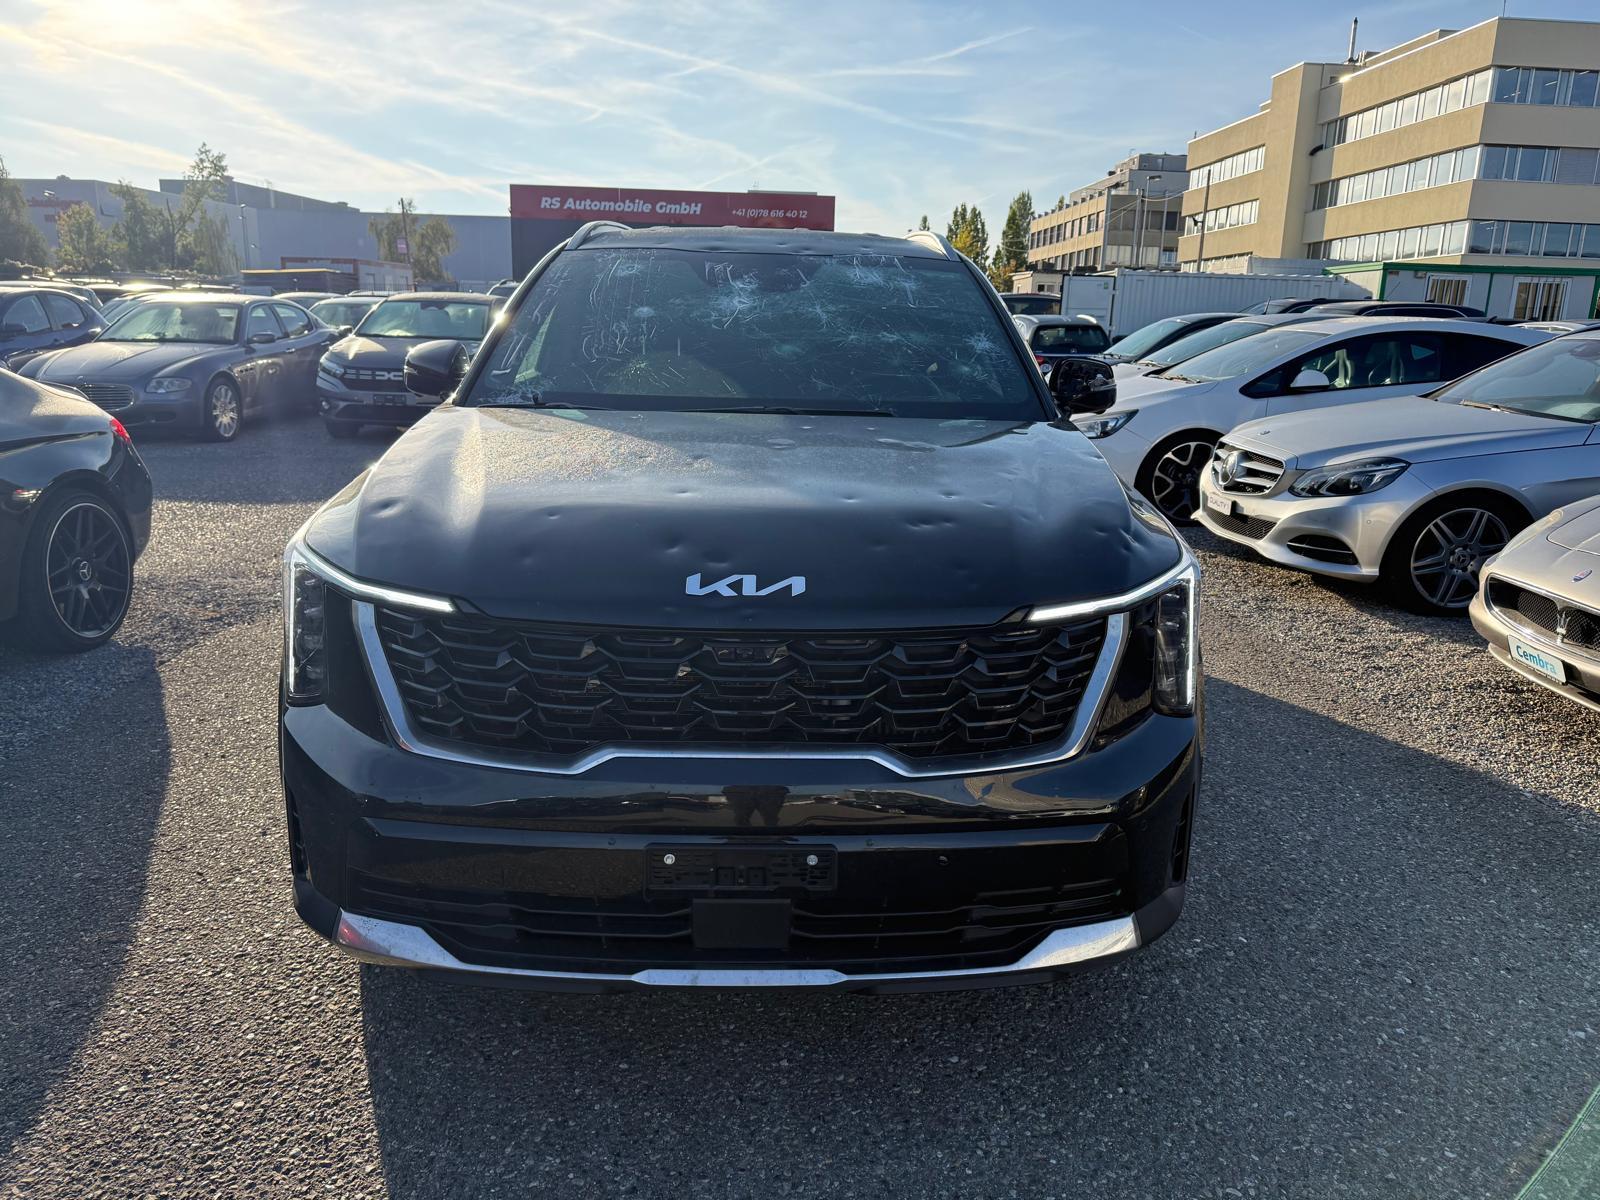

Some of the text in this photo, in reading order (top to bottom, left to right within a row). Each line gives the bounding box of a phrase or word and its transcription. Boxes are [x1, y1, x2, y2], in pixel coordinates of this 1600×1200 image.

[541, 196, 702, 215] RS Automobile GmbH
[732, 208, 745, 217] +41
[747, 208, 769, 218] (0)78
[770, 209, 784, 218] 616
[785, 210, 798, 218] 40
[1516, 645, 1557, 675] Cembra
